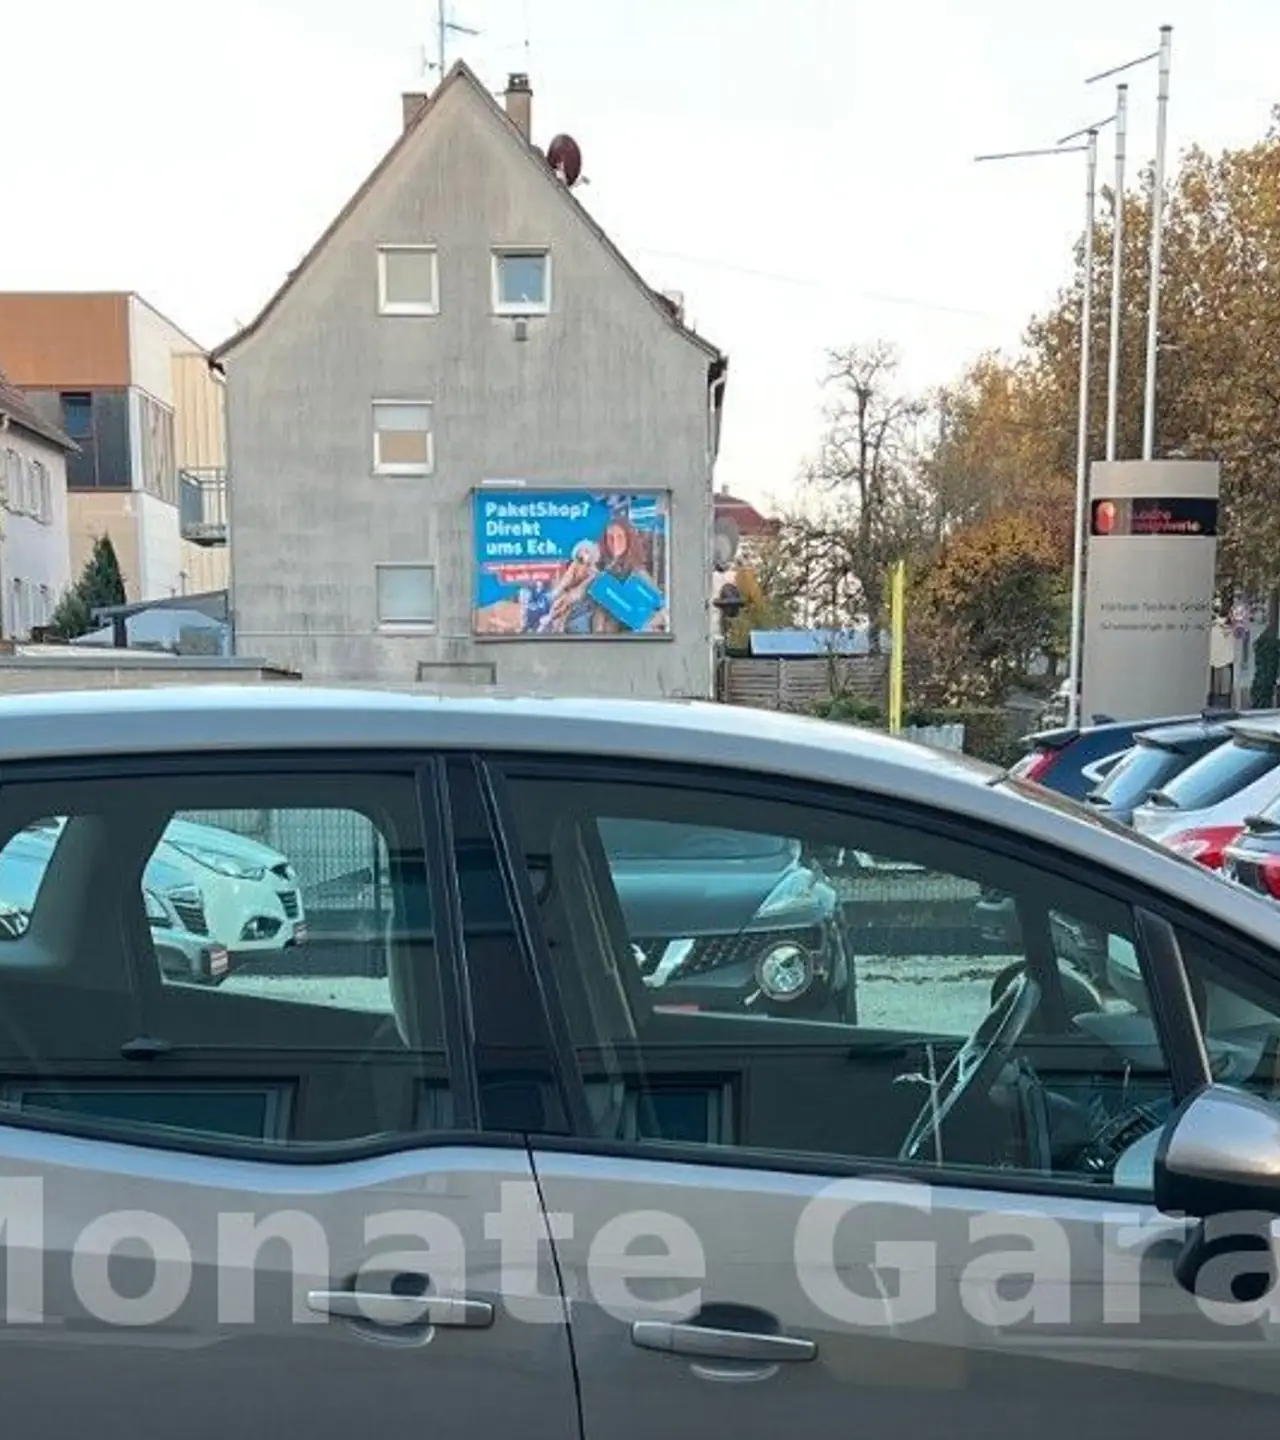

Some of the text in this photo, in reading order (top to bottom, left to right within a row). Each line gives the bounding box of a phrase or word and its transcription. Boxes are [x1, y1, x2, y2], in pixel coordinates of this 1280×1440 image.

[486, 503, 590, 519] PaketShop?
[486, 521, 541, 536] Direkt
[487, 543, 523, 555] ums
